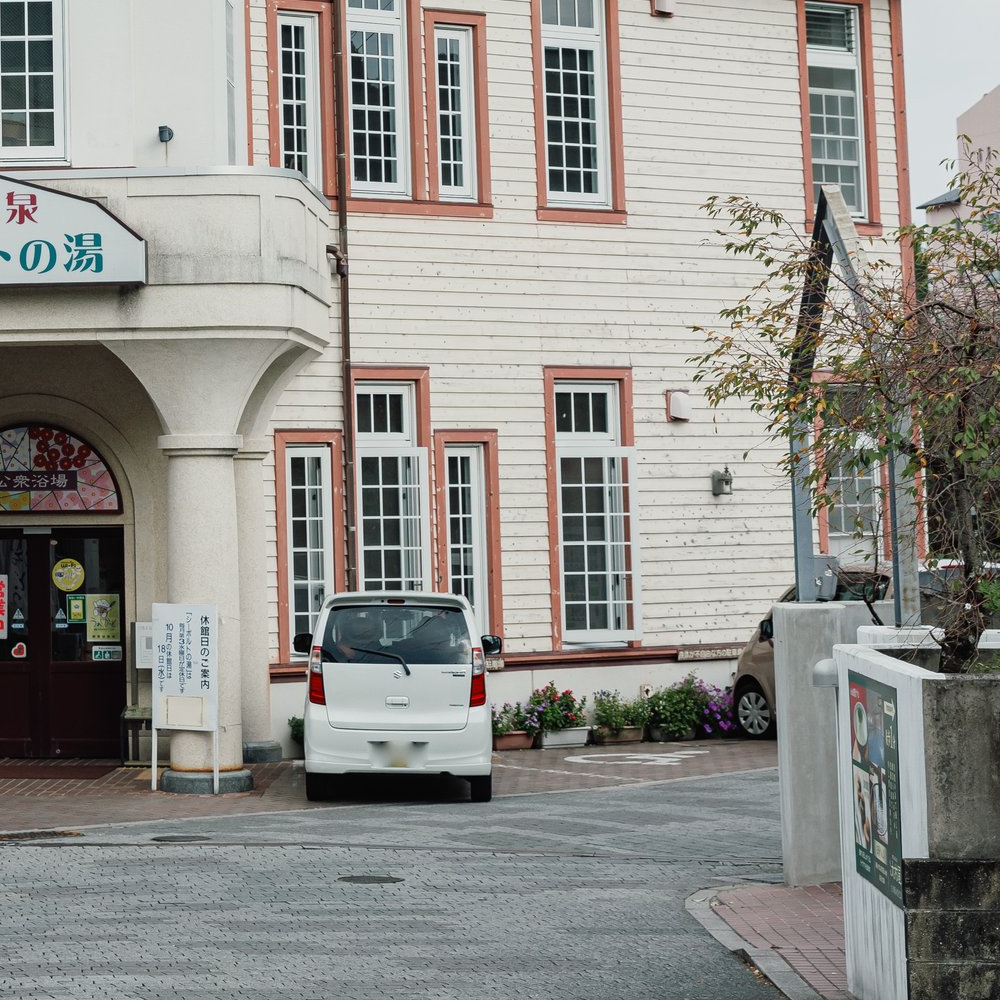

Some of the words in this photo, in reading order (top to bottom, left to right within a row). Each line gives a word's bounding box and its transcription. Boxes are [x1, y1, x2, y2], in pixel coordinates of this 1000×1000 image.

[200, 615, 210, 690] 休館日のご案内
